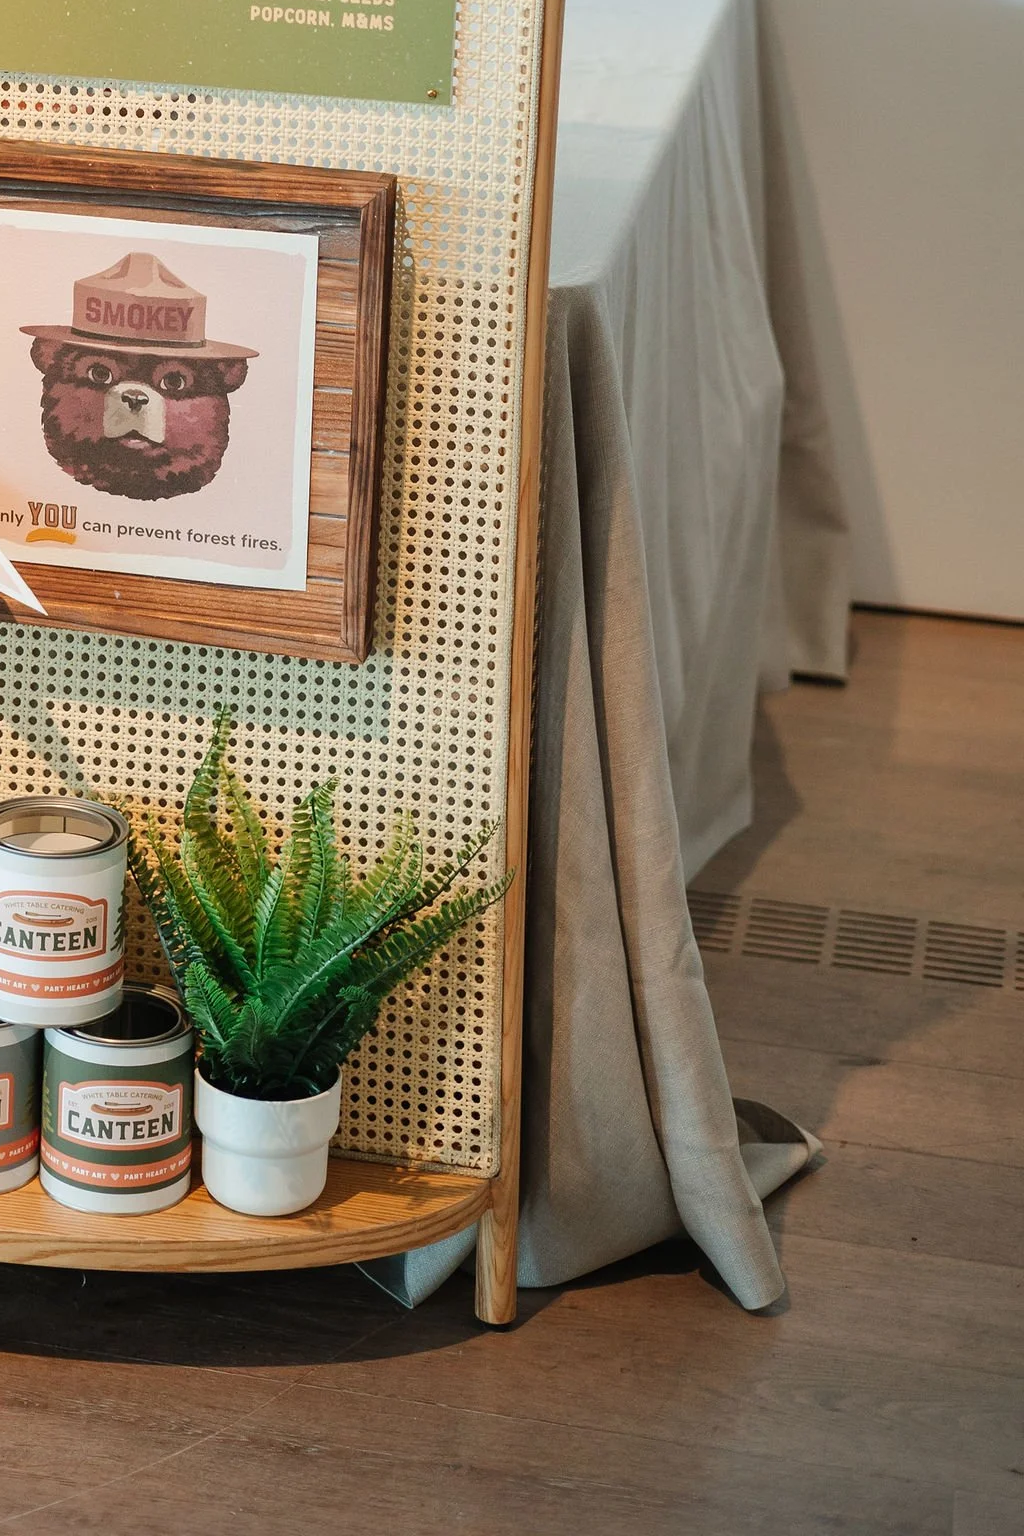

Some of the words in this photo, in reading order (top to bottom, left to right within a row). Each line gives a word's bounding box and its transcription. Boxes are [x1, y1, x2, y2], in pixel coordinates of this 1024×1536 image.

[342, 12, 394, 31] M&MS
[85, 296, 194, 332] SMOKEY
[27, 500, 77, 530] YOU
[82, 519, 112, 534] can
[117, 523, 181, 541] prevent
[187, 528, 236, 547] forest
[241, 534, 283, 552] fires.
[51, 903, 85, 914] CATERING
[13, 981, 27, 990] ART
[66, 982, 91, 991] HEART
[130, 1092, 164, 1101] CATERING
[67, 1109, 174, 1140] CANTEEN
[9, 1147, 24, 1157] PART
[71, 1166, 89, 1177] PART
[91, 1172, 107, 1180] ART
[145, 1168, 168, 1179] HEART
